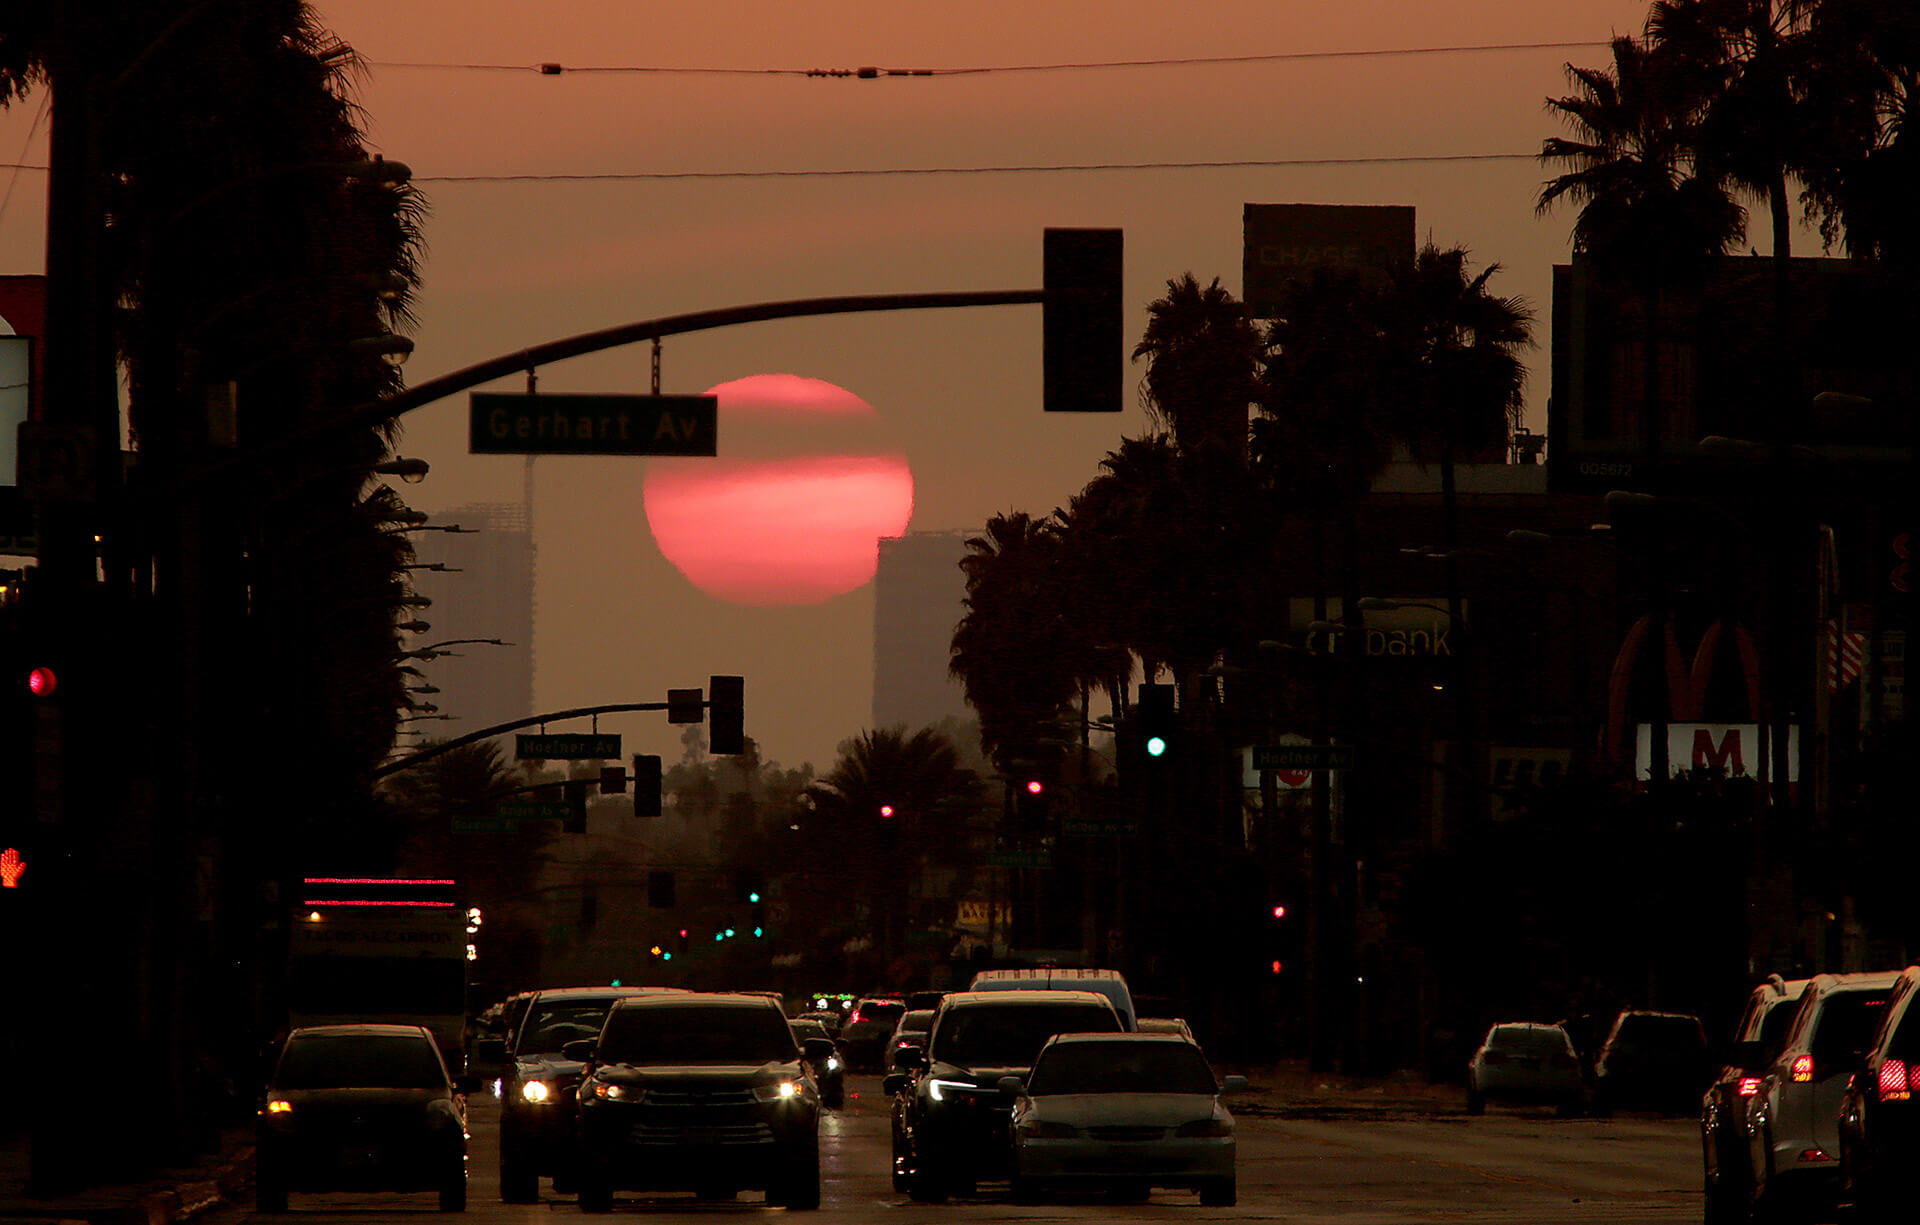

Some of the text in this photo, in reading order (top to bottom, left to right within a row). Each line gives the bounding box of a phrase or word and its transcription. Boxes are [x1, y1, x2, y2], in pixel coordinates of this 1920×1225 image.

[1259, 245, 1361, 266] CHASE
[488, 407, 700, 441] Gerhart Av
[594, 739, 614, 753] Av
[1692, 729, 1744, 777] M
